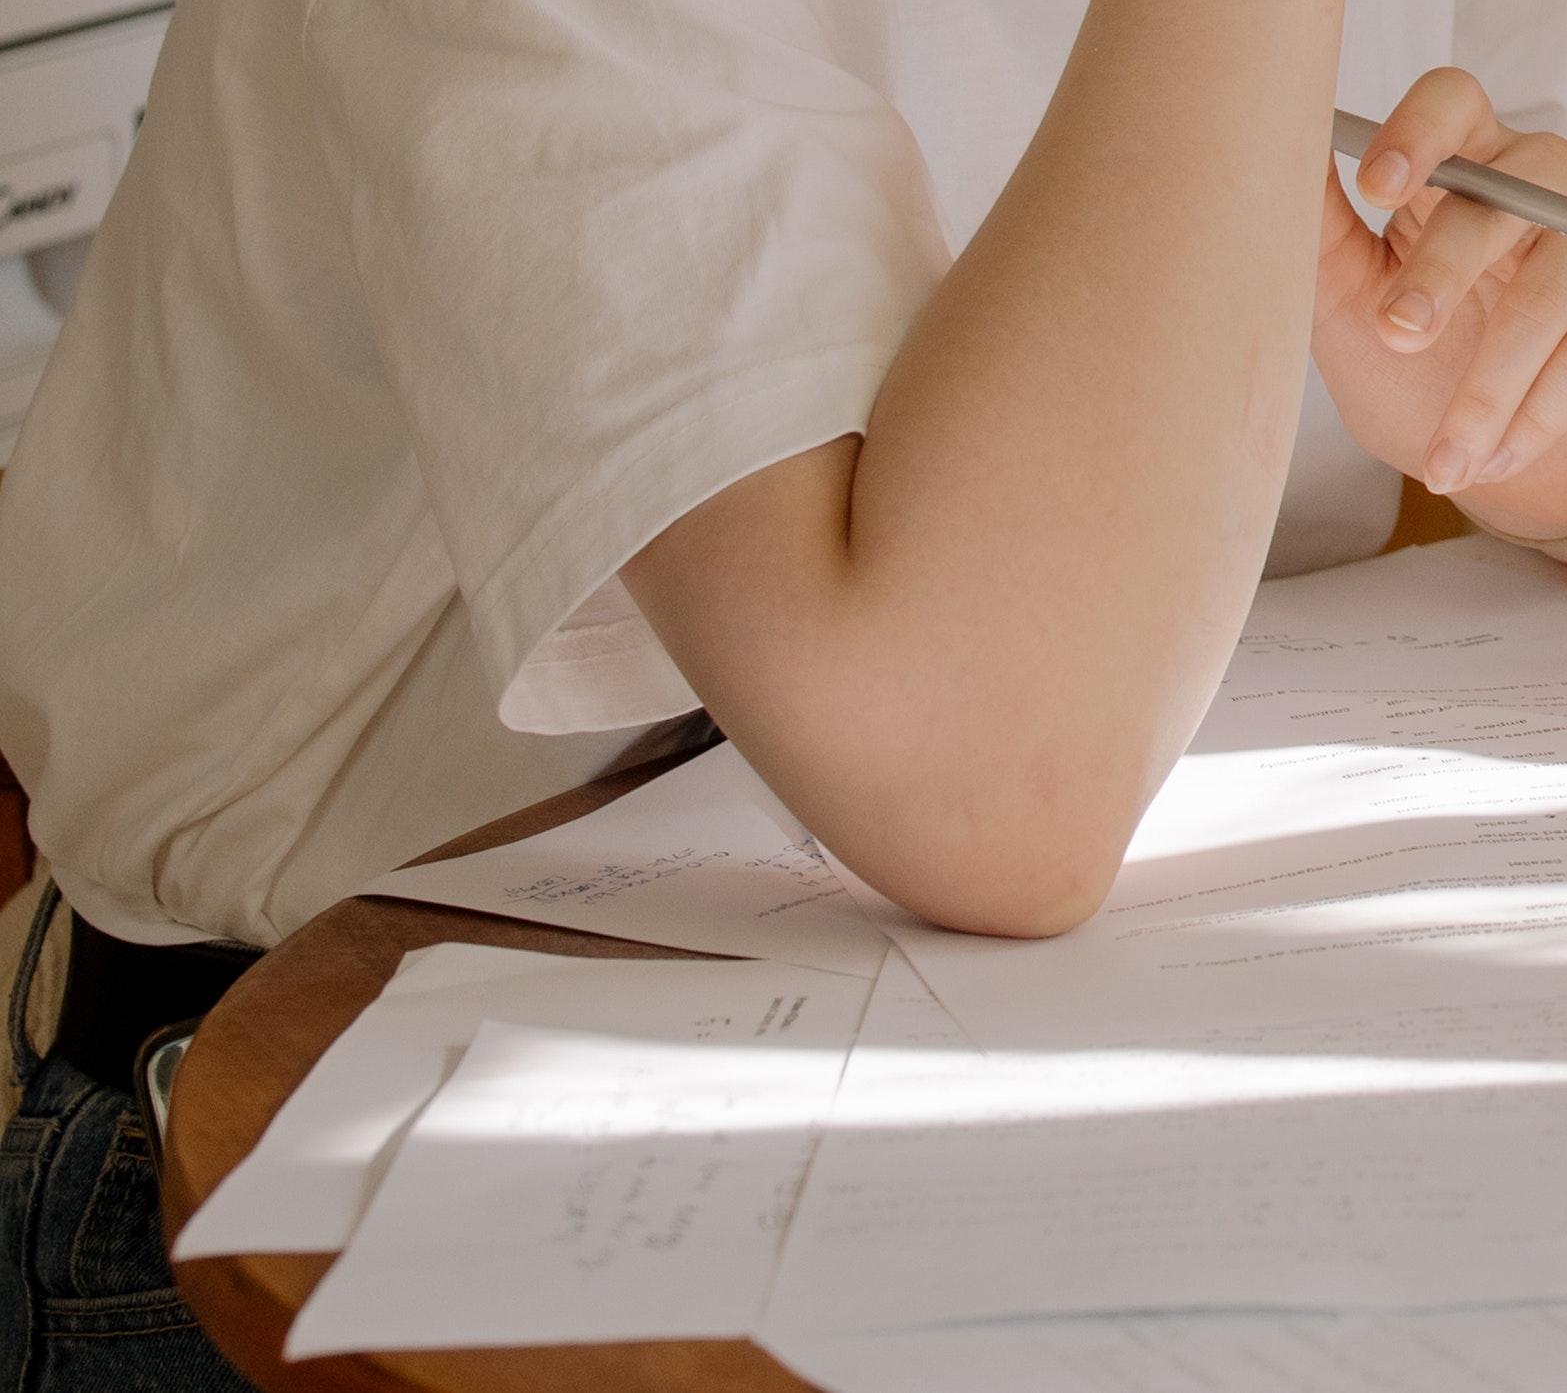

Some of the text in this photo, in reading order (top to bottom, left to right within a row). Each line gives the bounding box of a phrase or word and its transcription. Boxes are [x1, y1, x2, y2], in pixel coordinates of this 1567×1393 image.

[1230, 692, 1273, 702] circuit
[1289, 707, 1350, 719] coulomb
[1384, 709, 1434, 719] charge
[1473, 719, 1527, 730] ampere
[1315, 737, 1377, 746] coulomb
[1426, 735, 1500, 744] resistance
[1500, 751, 1554, 759] ampere
[1340, 764, 1403, 779] coulomb
[1473, 819, 1527, 828] parallel
[1470, 835, 1526, 844] positive
[1398, 841, 1467, 853] terminals
[1365, 851, 1393, 859] and
[1338, 858, 1362, 866] the
[1507, 859, 1562, 867] parallel
[1269, 864, 1333, 880] negative
[1427, 875, 1506, 884] appliances
[1197, 879, 1266, 895] terminals
[1411, 883, 1477, 891] batteries
[1107, 898, 1174, 913] batteries
